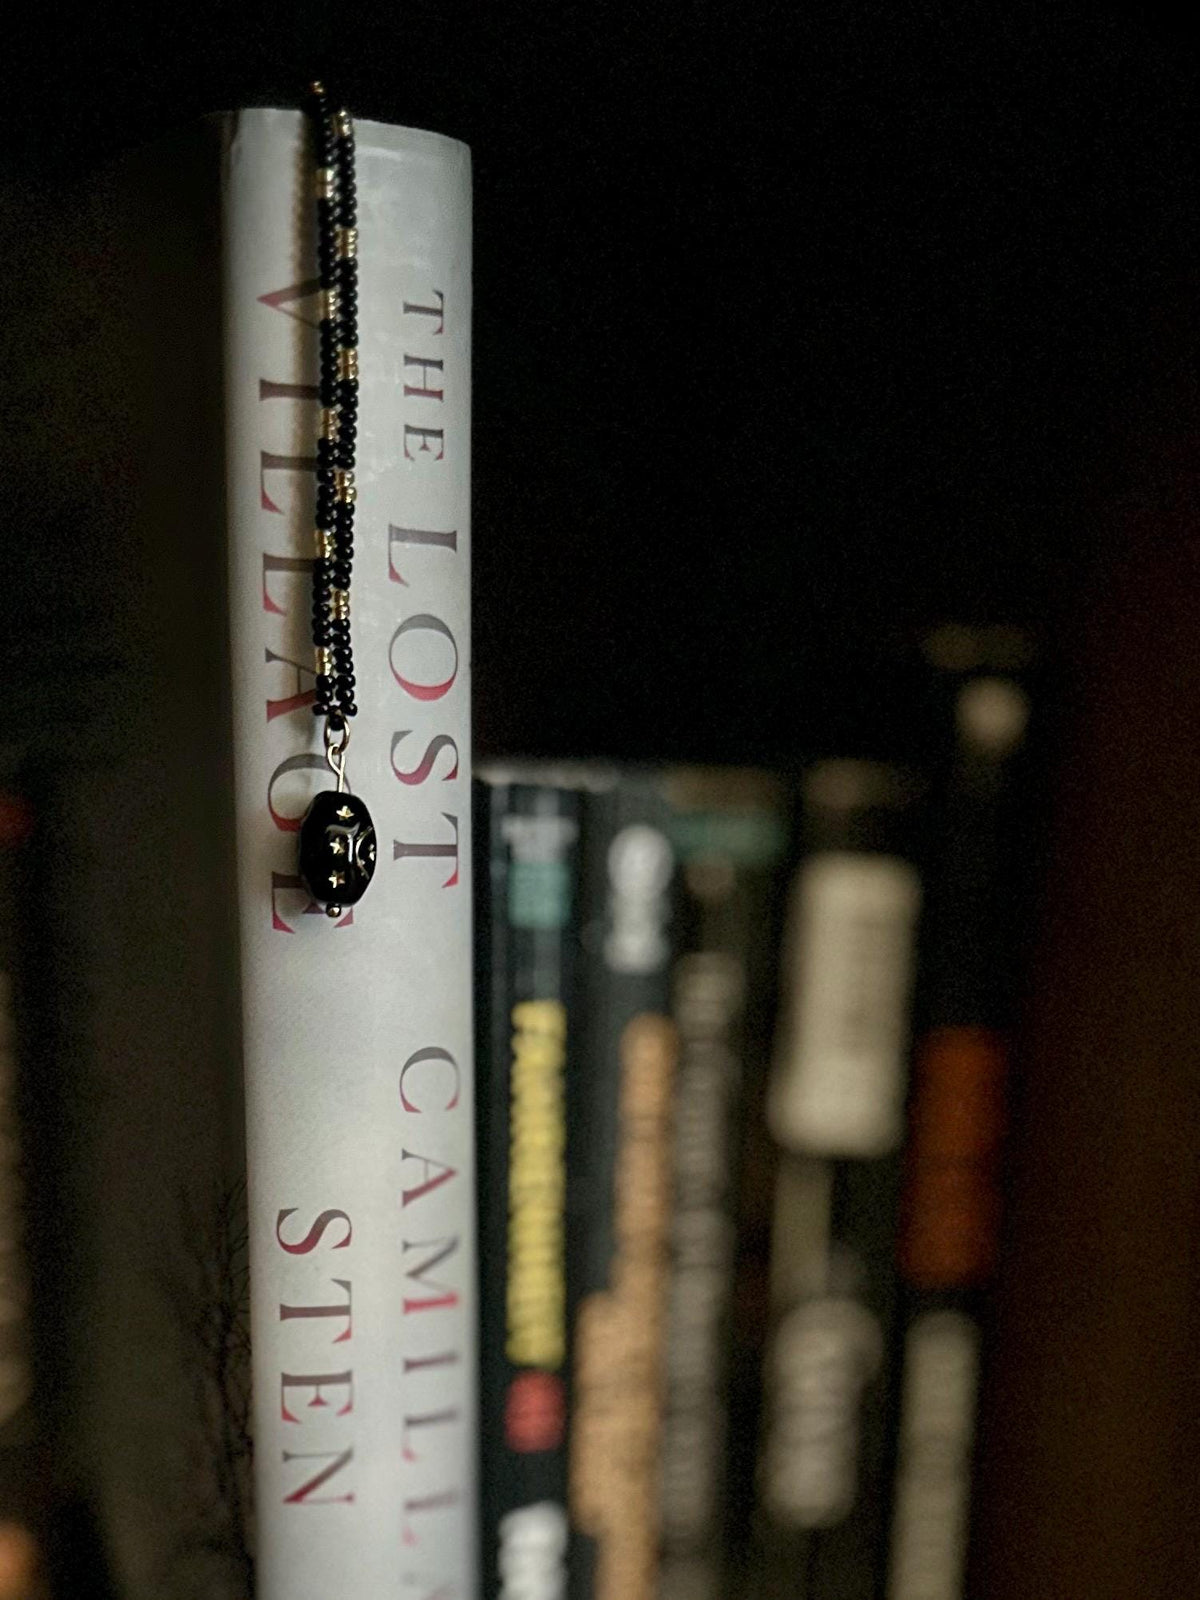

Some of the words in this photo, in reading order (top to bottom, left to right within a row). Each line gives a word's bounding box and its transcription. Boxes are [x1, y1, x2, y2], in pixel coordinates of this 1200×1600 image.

[402, 289, 444, 462] THE
[388, 523, 459, 889] LOST
[276, 1207, 354, 1505] STEN
